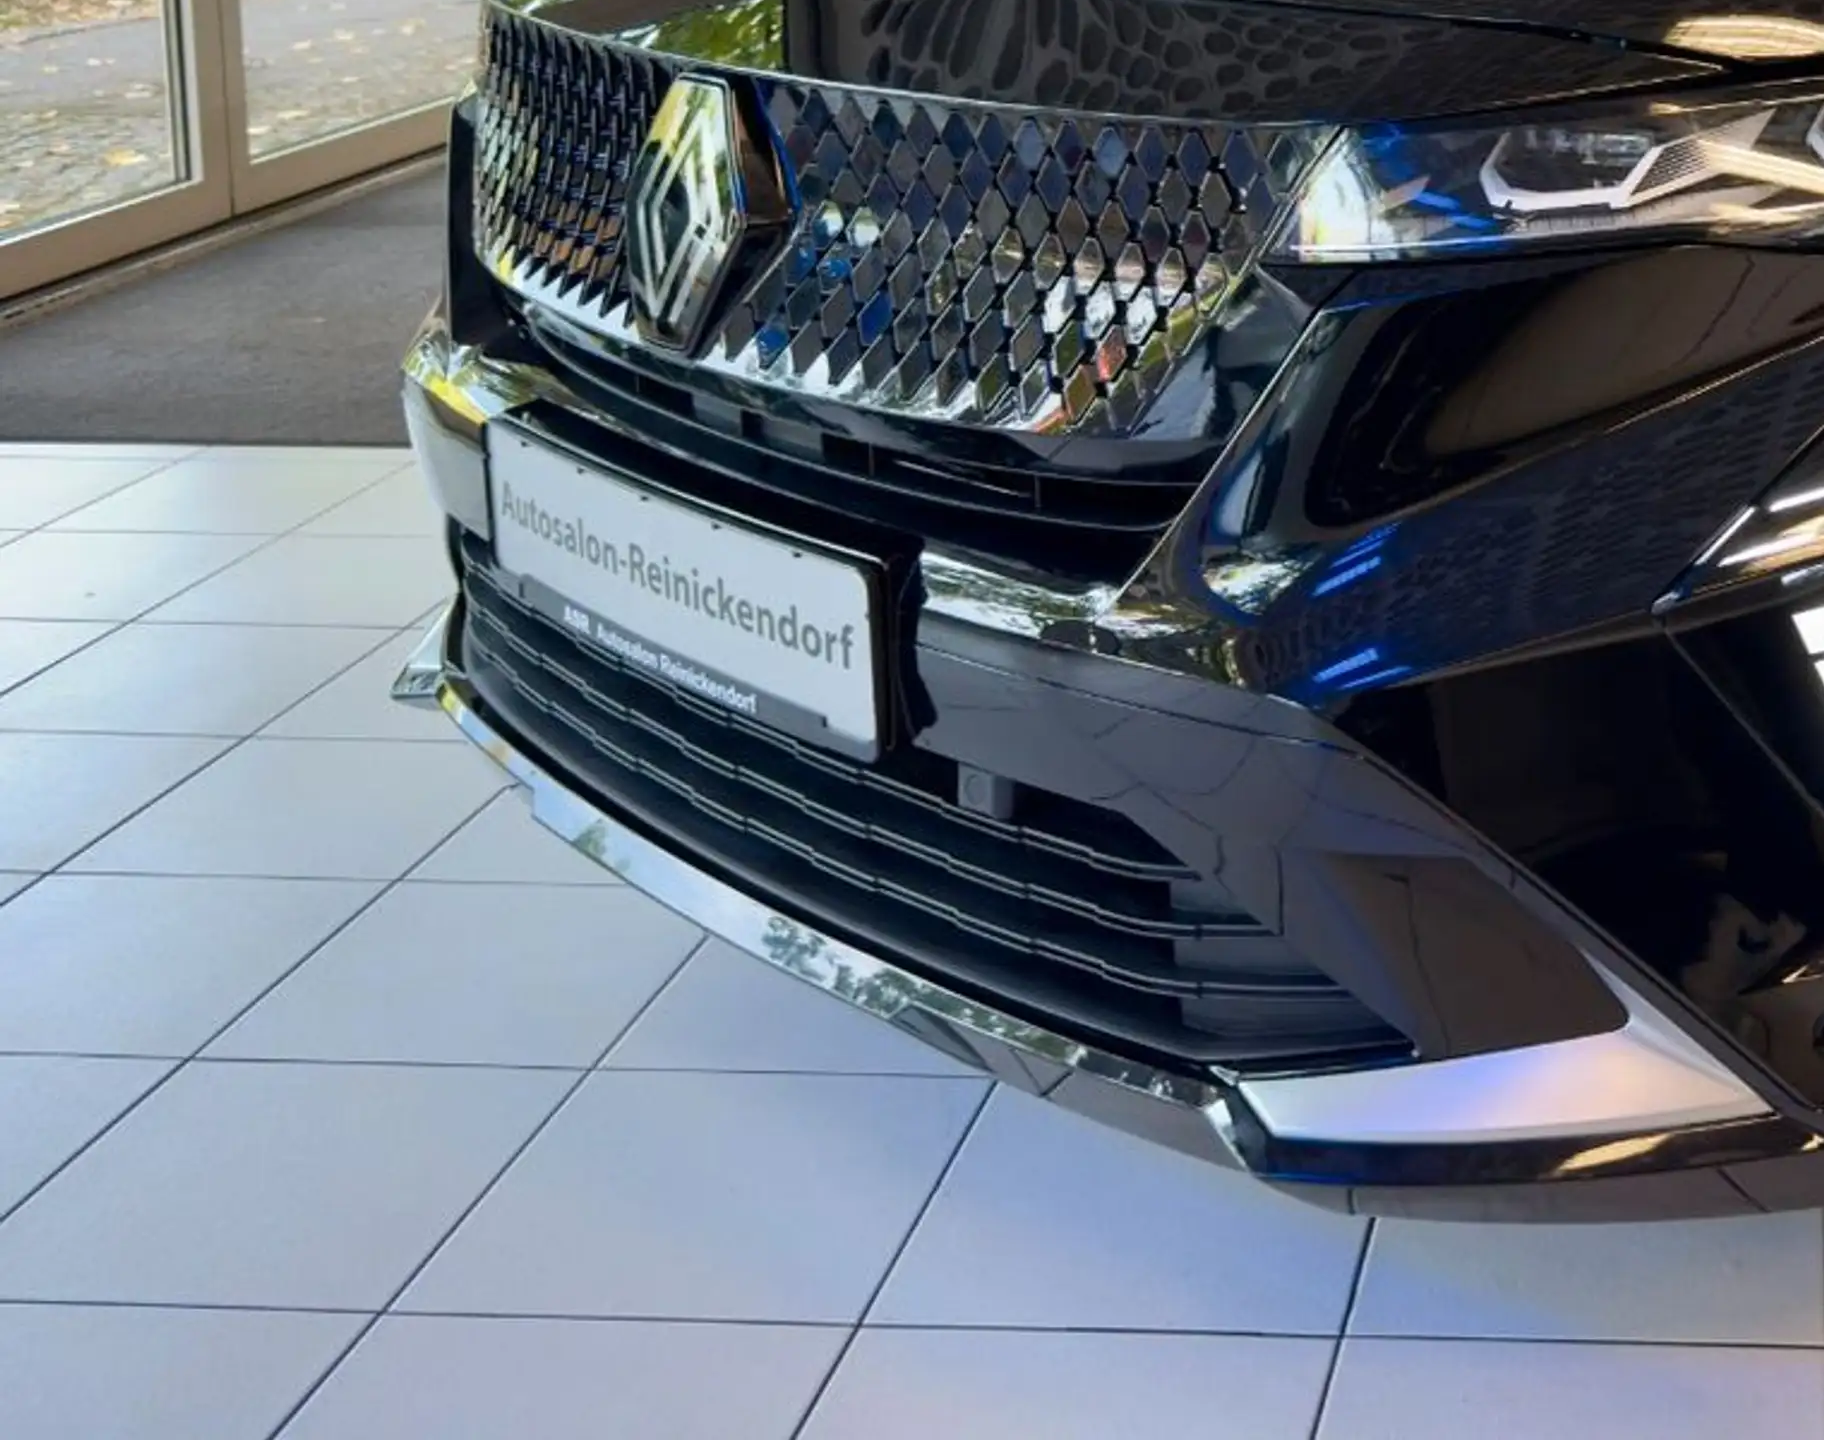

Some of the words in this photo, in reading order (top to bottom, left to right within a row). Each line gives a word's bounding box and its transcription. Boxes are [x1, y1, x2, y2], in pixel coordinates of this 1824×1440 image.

[502, 480, 855, 669] Autosalon-Reinickendorf
[597, 622, 658, 670] Autosalon
[660, 652, 757, 715] Reinickendorf
